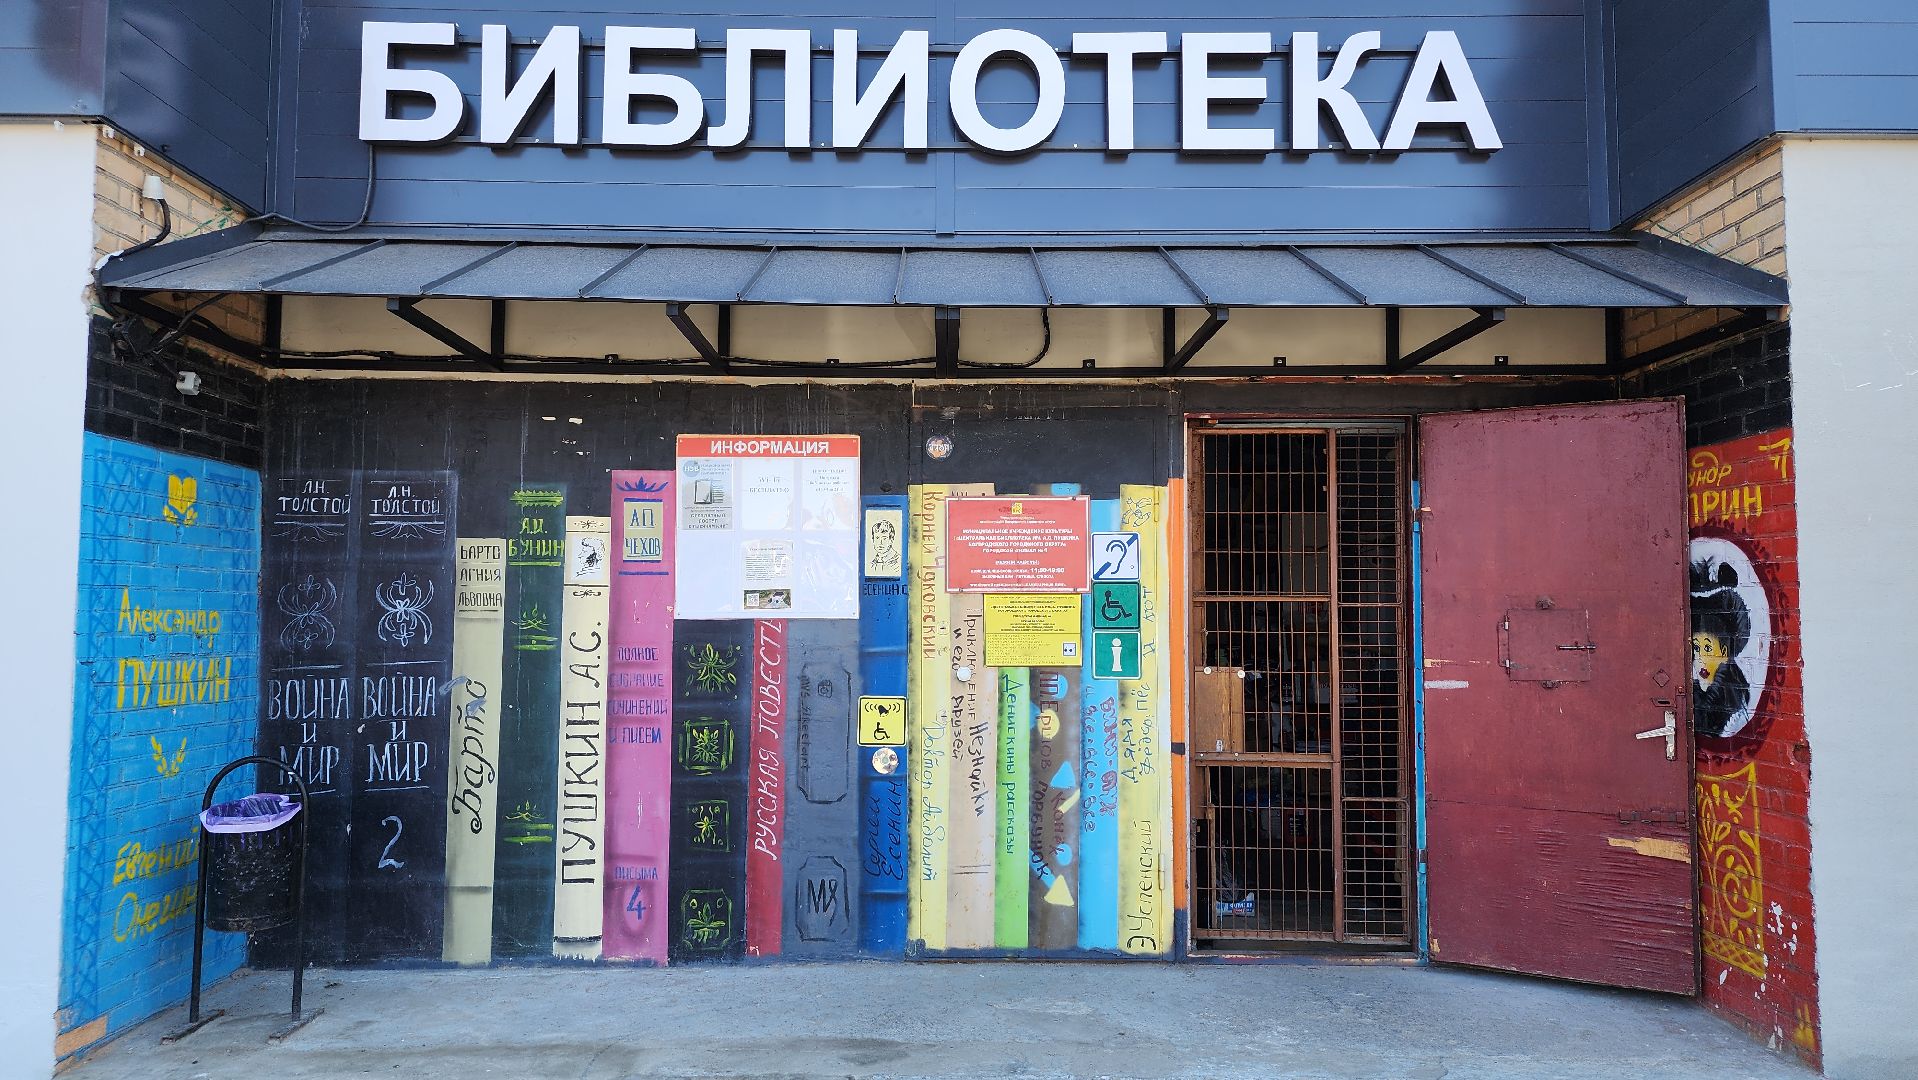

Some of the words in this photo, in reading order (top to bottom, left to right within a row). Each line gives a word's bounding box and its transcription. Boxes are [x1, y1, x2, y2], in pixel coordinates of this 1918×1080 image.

[359, 21, 1503, 155] БИБЛИОТЕКА
[710, 440, 830, 456] ИНФОРМАЦИЯ
[278, 494, 351, 514] ТОЛСТОЙ
[371, 496, 441, 514] ТОЛСТОЙ
[520, 517, 548, 535] А.И.
[625, 537, 661, 556] ЧЕХОВ
[508, 540, 565, 557] БУНИН
[460, 568, 501, 582] АГНИЯ
[117, 586, 222, 649] Александр
[458, 591, 503, 608] ЛЬВОВНА
[569, 621, 603, 688] А.С.
[617, 647, 659, 662] ПОЛНОЕ
[117, 656, 232, 710] ПУШКИН
[268, 675, 350, 720] ВОЙНА
[361, 671, 436, 720] ВОЙНА
[758, 618, 785, 740] ПОВЕСТЬ
[301, 722, 317, 744] И
[389, 720, 407, 741] И
[622, 726, 662, 744] ПИСЕМ
[1001, 673, 1024, 774] Денискины
[278, 745, 340, 786] МИР
[364, 741, 429, 782] МИР
[561, 700, 601, 886] ПУШКИН
[754, 747, 780, 861] РУССКАЯ
[880, 779, 905, 881] Есенин
[1002, 782, 1017, 855] рассказы
[378, 815, 405, 869] 2
[626, 884, 647, 921] 4
